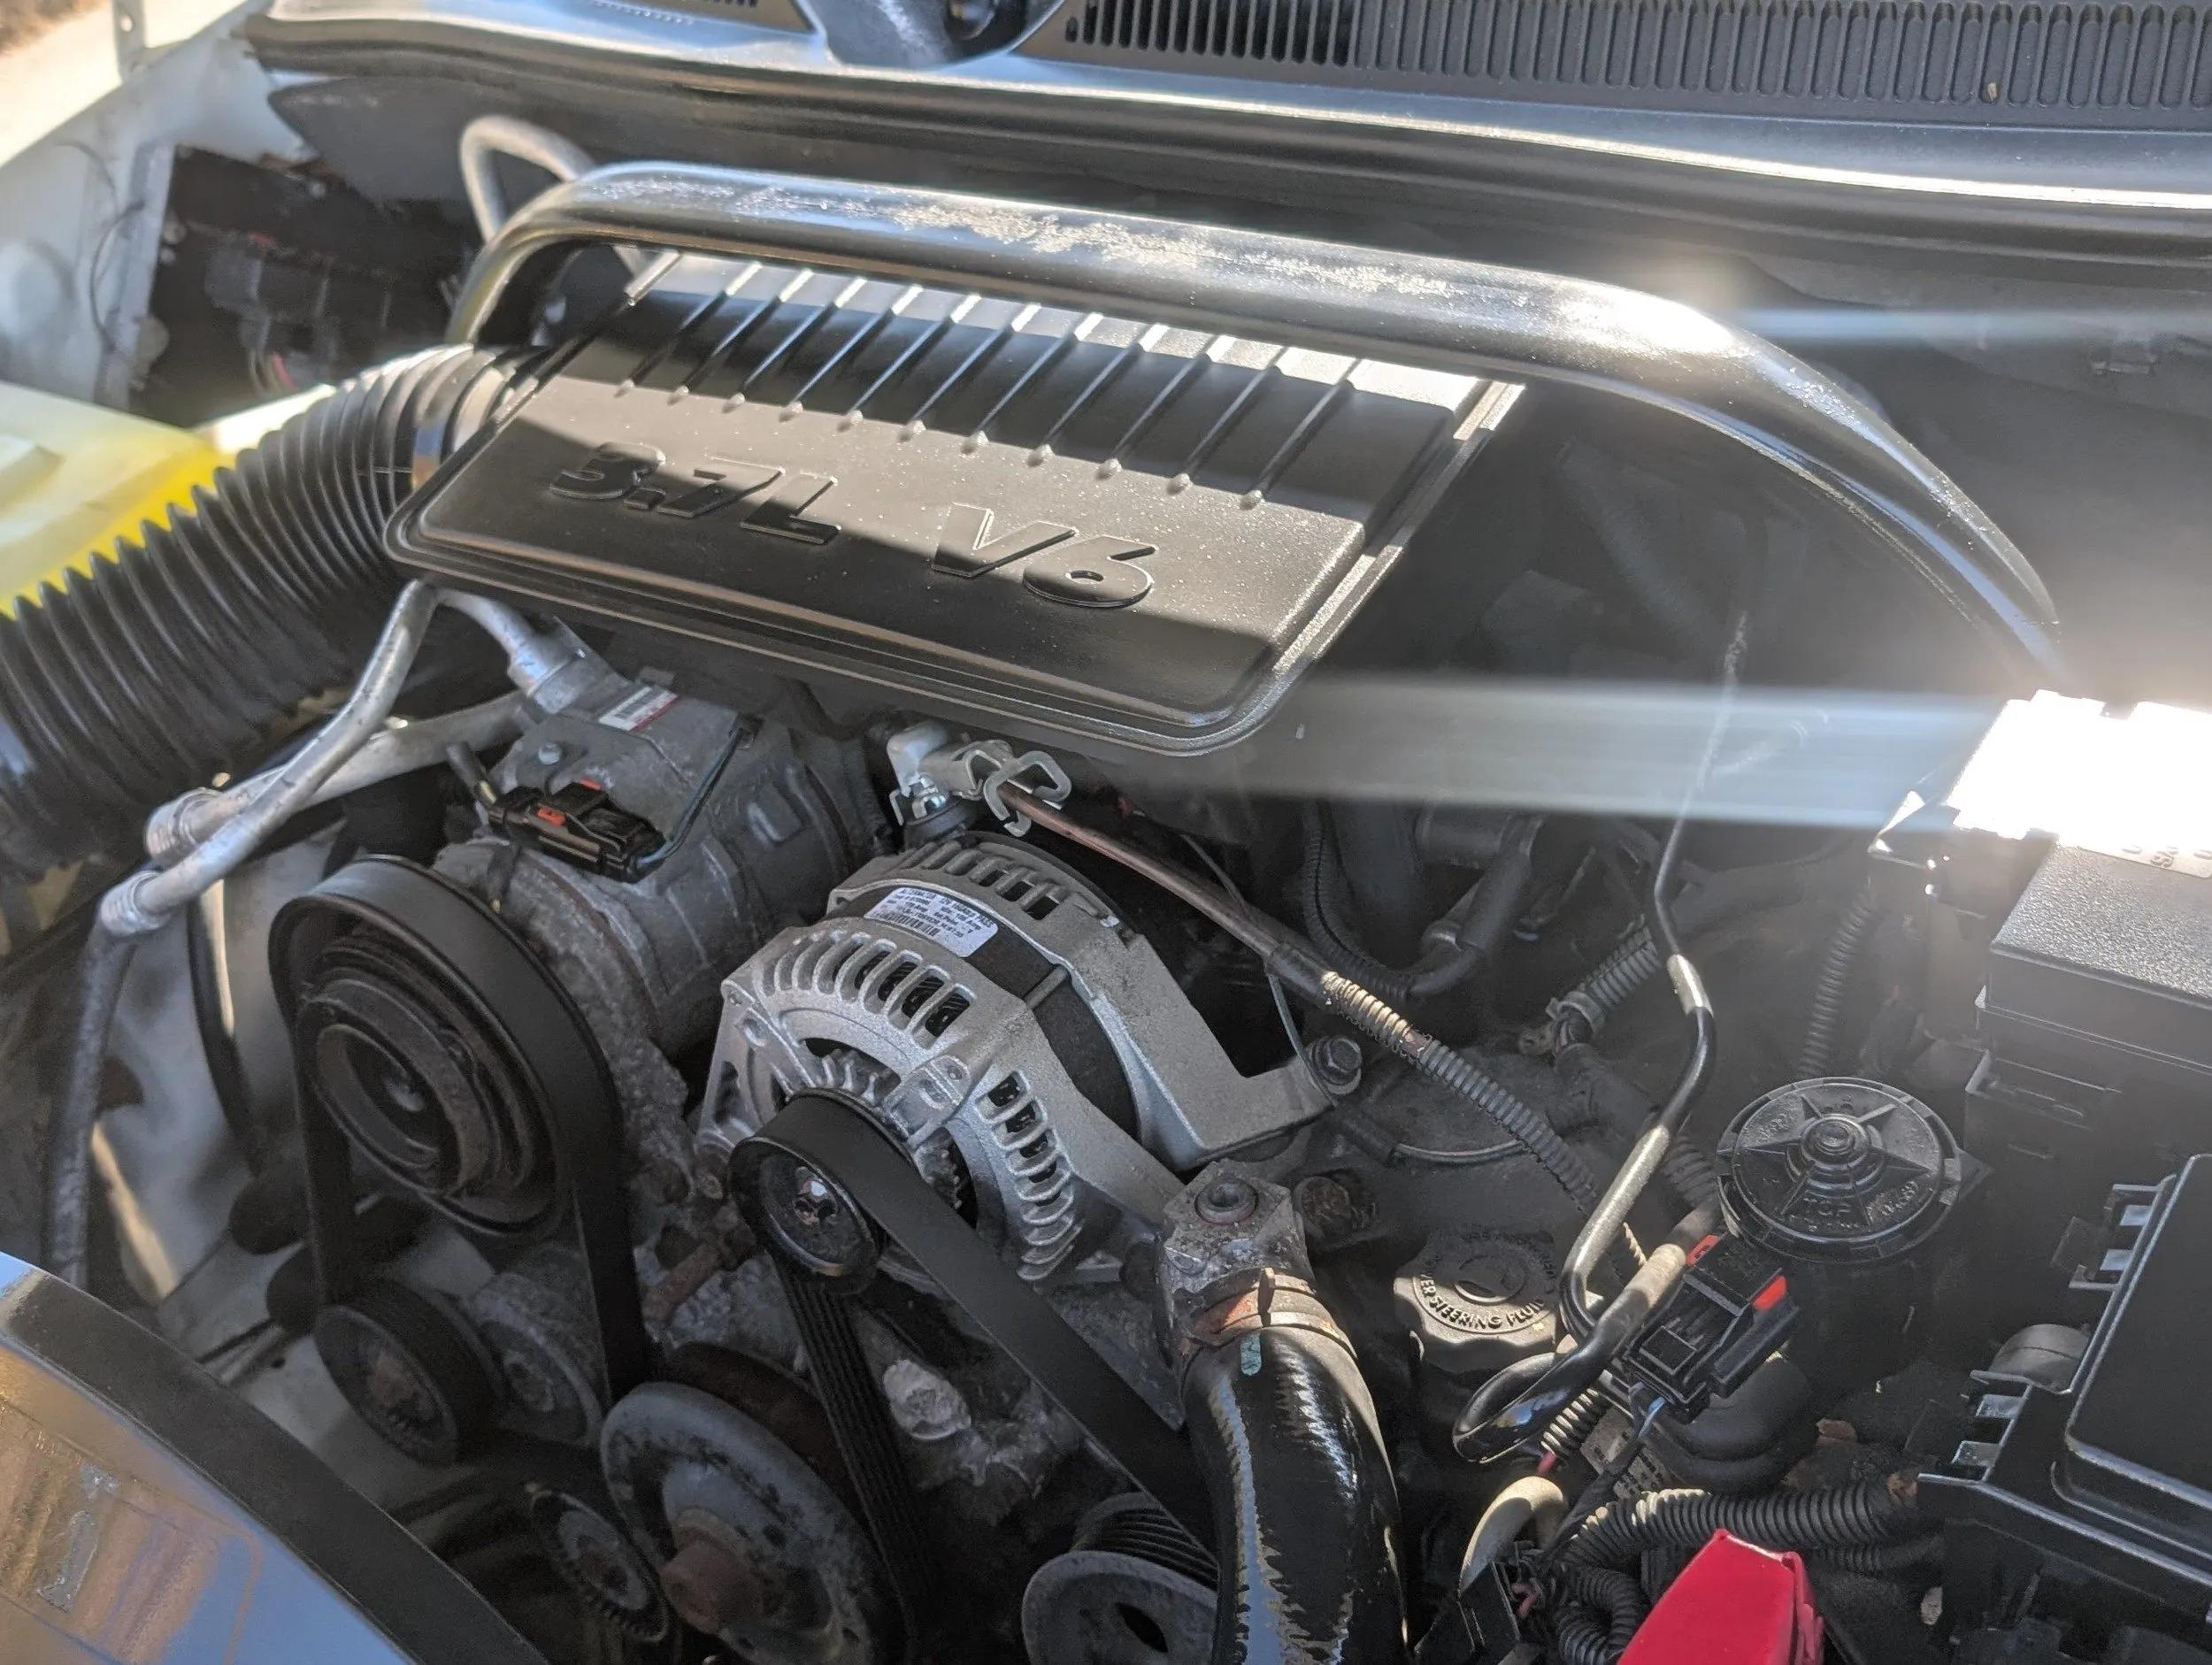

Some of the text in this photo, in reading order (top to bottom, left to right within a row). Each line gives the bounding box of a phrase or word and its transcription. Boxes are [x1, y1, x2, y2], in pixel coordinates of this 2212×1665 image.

[549, 441, 1160, 609] 3.7L V6
[1429, 1295, 1502, 1329] STEERING
